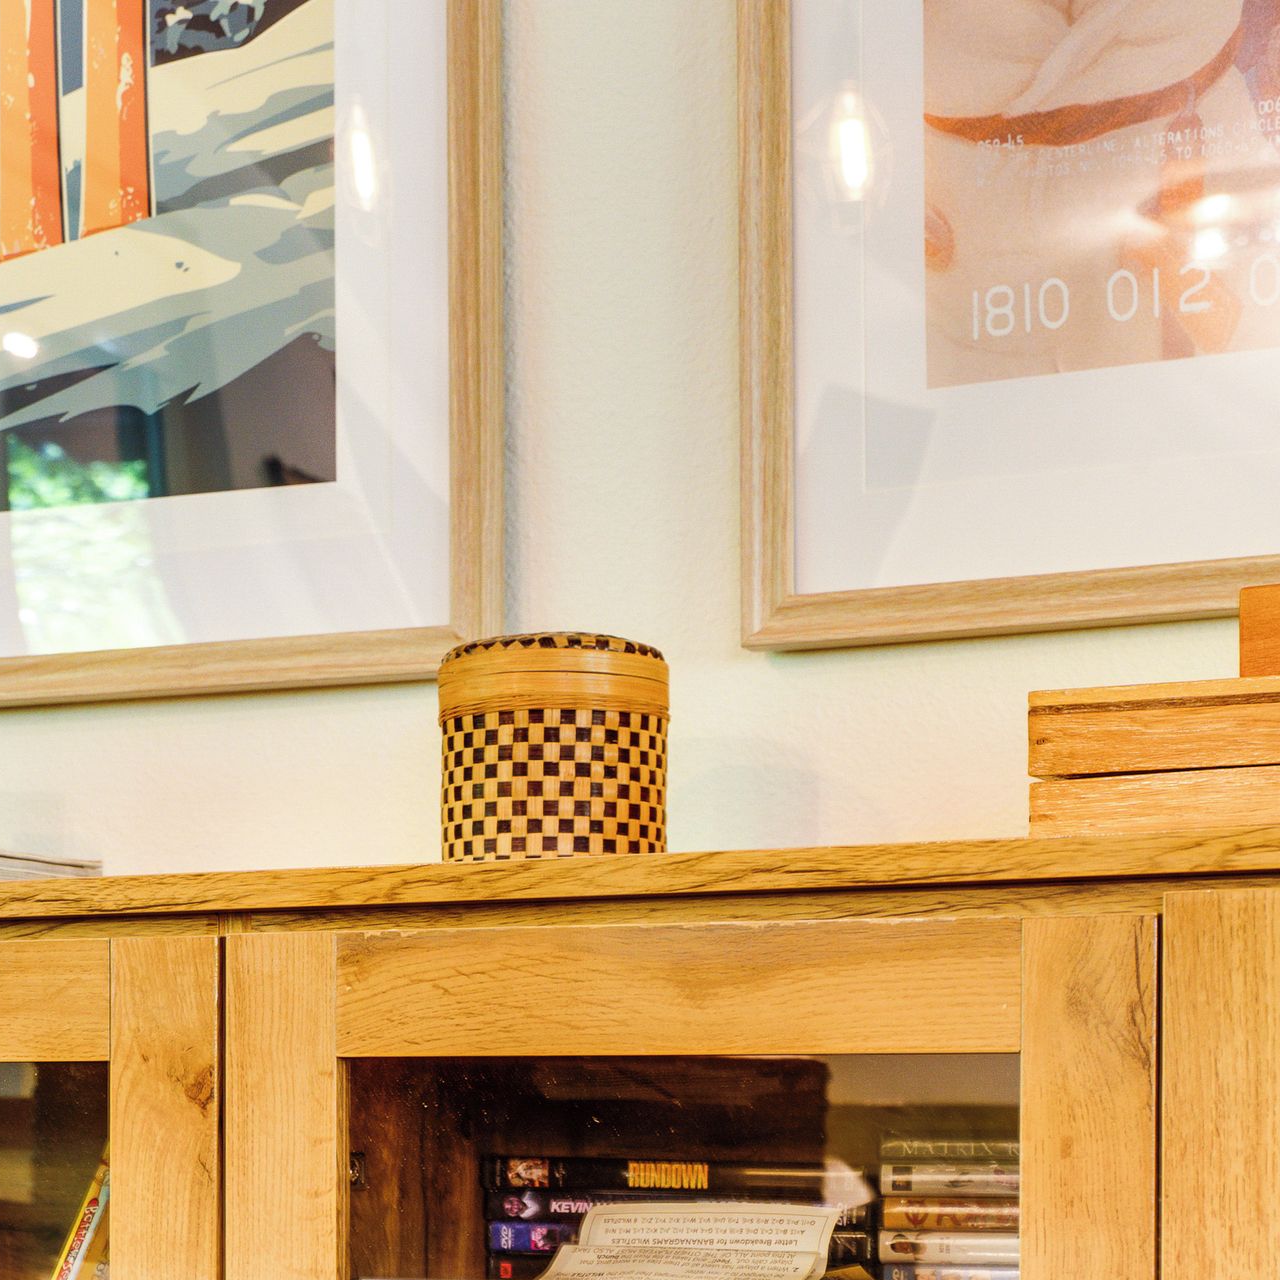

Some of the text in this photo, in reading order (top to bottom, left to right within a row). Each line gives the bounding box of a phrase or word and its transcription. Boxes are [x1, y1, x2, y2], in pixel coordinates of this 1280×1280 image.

[969, 276, 1071, 340] 1810
[1105, 261, 1213, 323] 012
[628, 1160, 709, 1190] RUNDOWN
